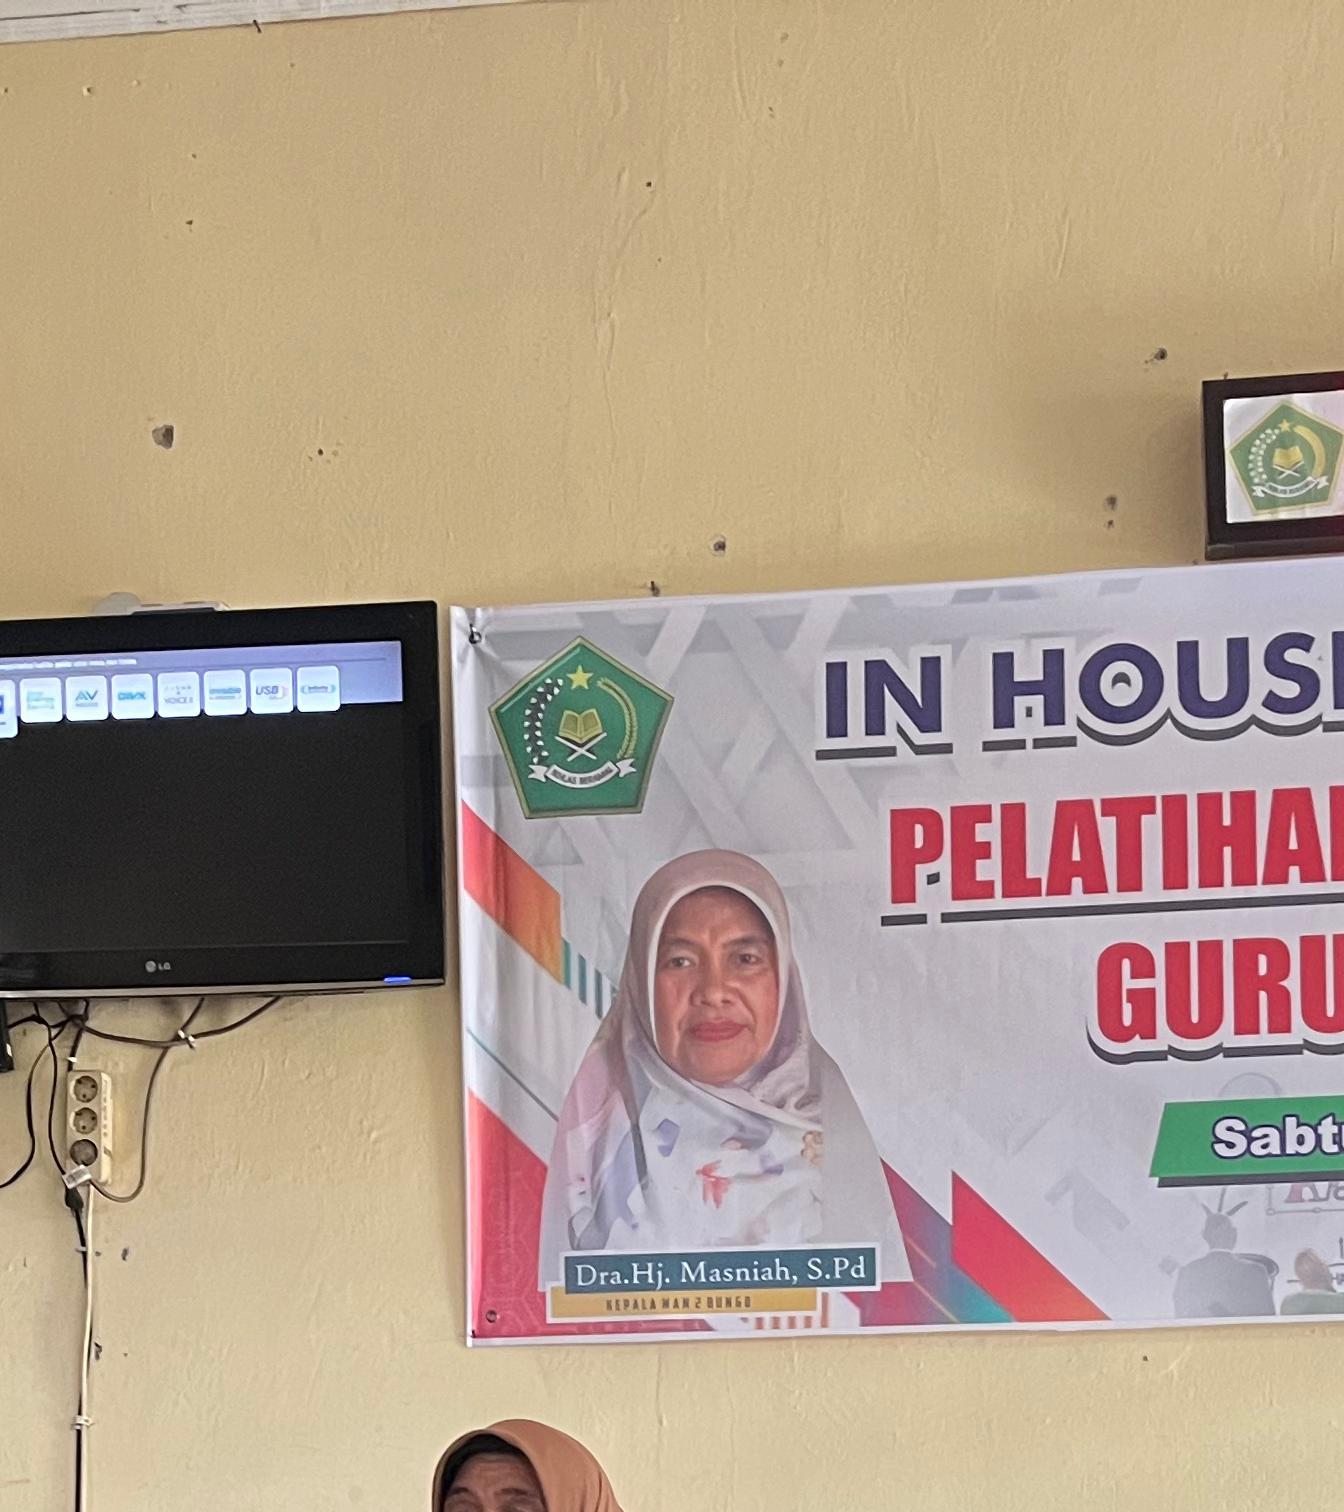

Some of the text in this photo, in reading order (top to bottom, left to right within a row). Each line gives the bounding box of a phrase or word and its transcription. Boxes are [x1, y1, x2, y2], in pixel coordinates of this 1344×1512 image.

[826, 656, 943, 742] IN
[575, 1255, 866, 1291] Dra.Hj. Masniah, S.Pd
[605, 1298, 657, 1311] KEPALA
